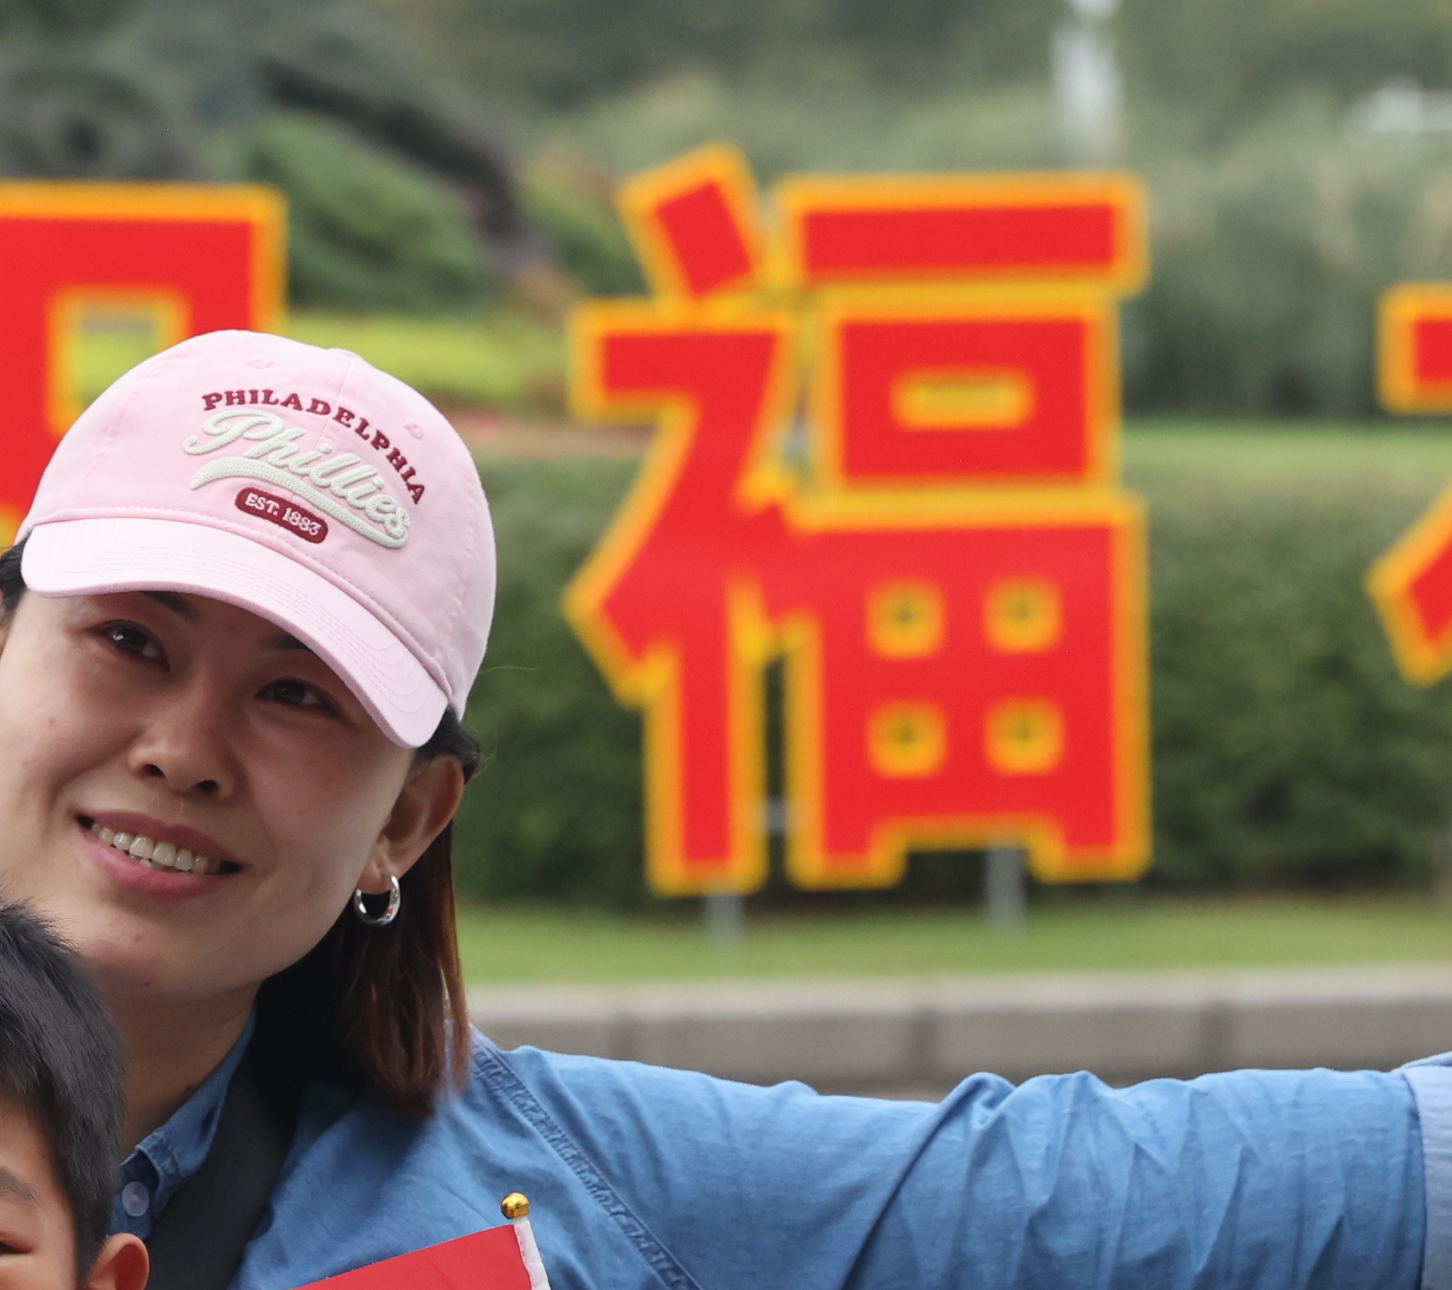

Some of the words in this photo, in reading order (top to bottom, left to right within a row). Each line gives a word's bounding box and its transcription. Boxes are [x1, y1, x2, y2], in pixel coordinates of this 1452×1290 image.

[183, 408, 412, 541] Phillies
[202, 389, 425, 505] PHILADELPHIA
[245, 492, 279, 517] EST.
[282, 507, 323, 537] 1883
